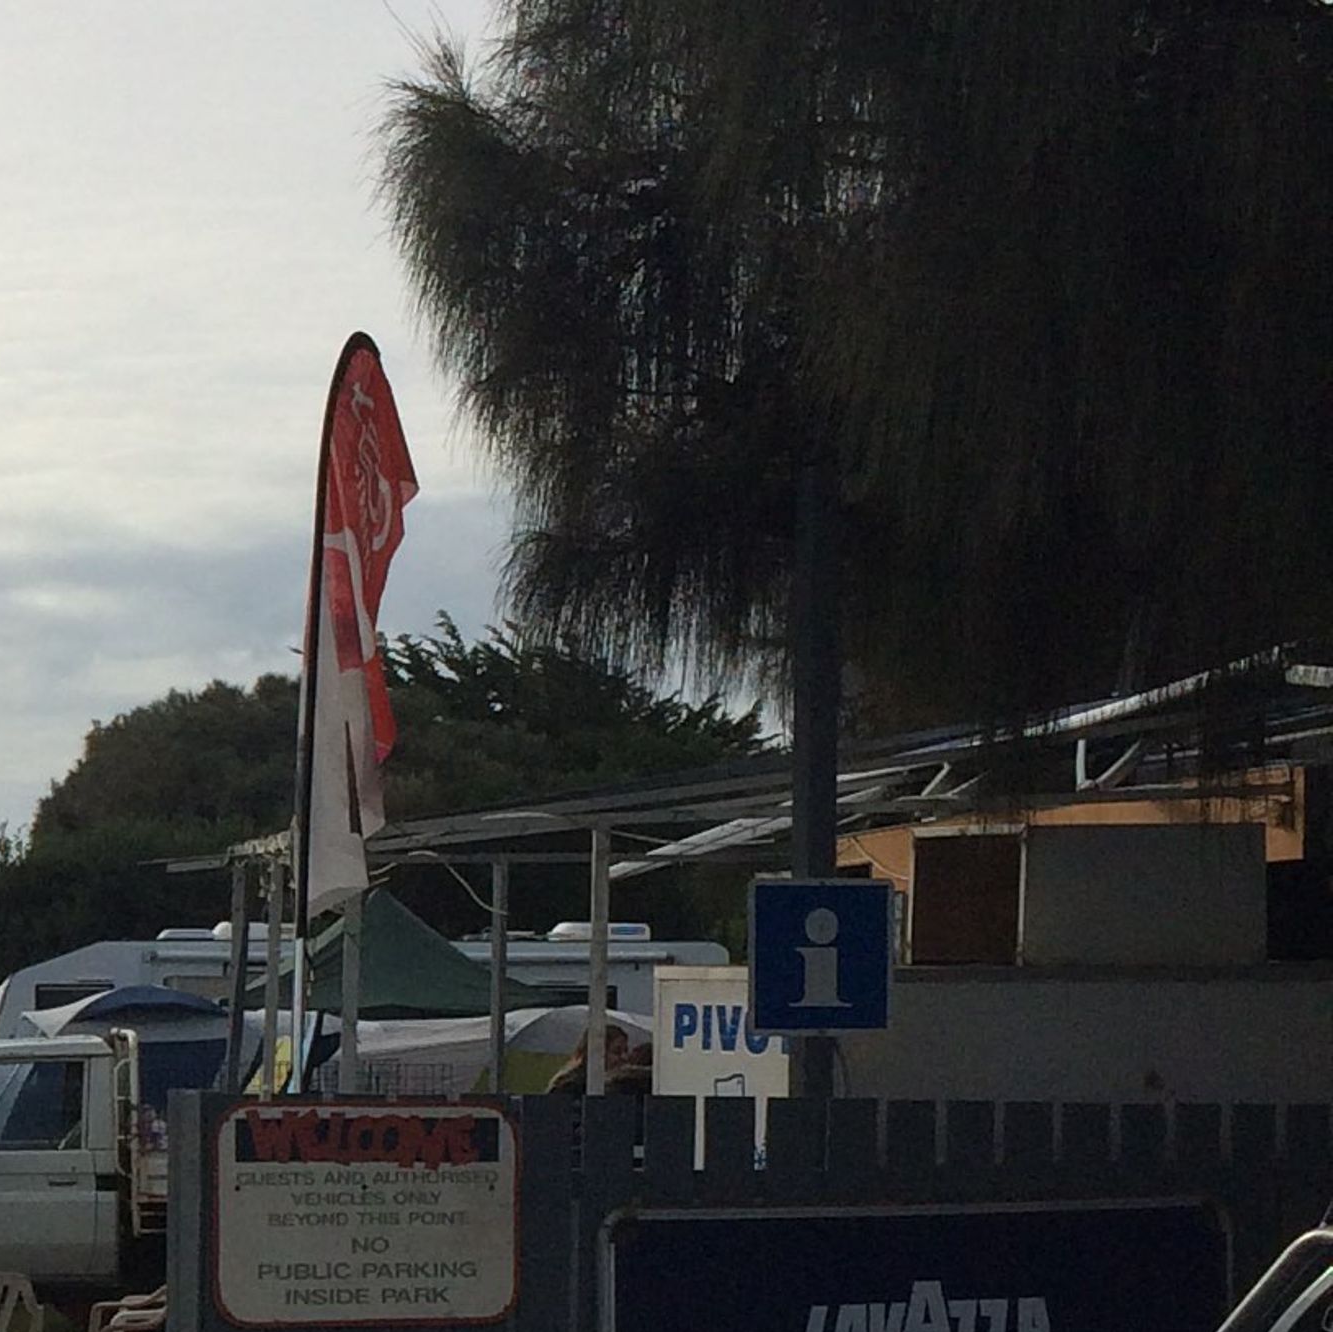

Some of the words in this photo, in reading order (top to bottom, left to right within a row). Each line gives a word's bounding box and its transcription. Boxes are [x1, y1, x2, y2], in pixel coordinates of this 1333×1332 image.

[674, 1003, 790, 1054] PIV
[236, 1171, 315, 1187] GUESTS
[324, 1171, 365, 1186] AND
[372, 1169, 499, 1185] AUTHORISED
[290, 1190, 386, 1206] VEHICLES
[393, 1190, 442, 1206] ONLY
[267, 1211, 349, 1228] BEYOND
[356, 1211, 401, 1227] THIS
[408, 1210, 469, 1227] POINT
[351, 1236, 390, 1254] NO
[257, 1262, 352, 1281] PUBLIC
[361, 1261, 478, 1280] PARKING
[284, 1287, 371, 1306] INSIDE
[380, 1286, 451, 1305] PARK
